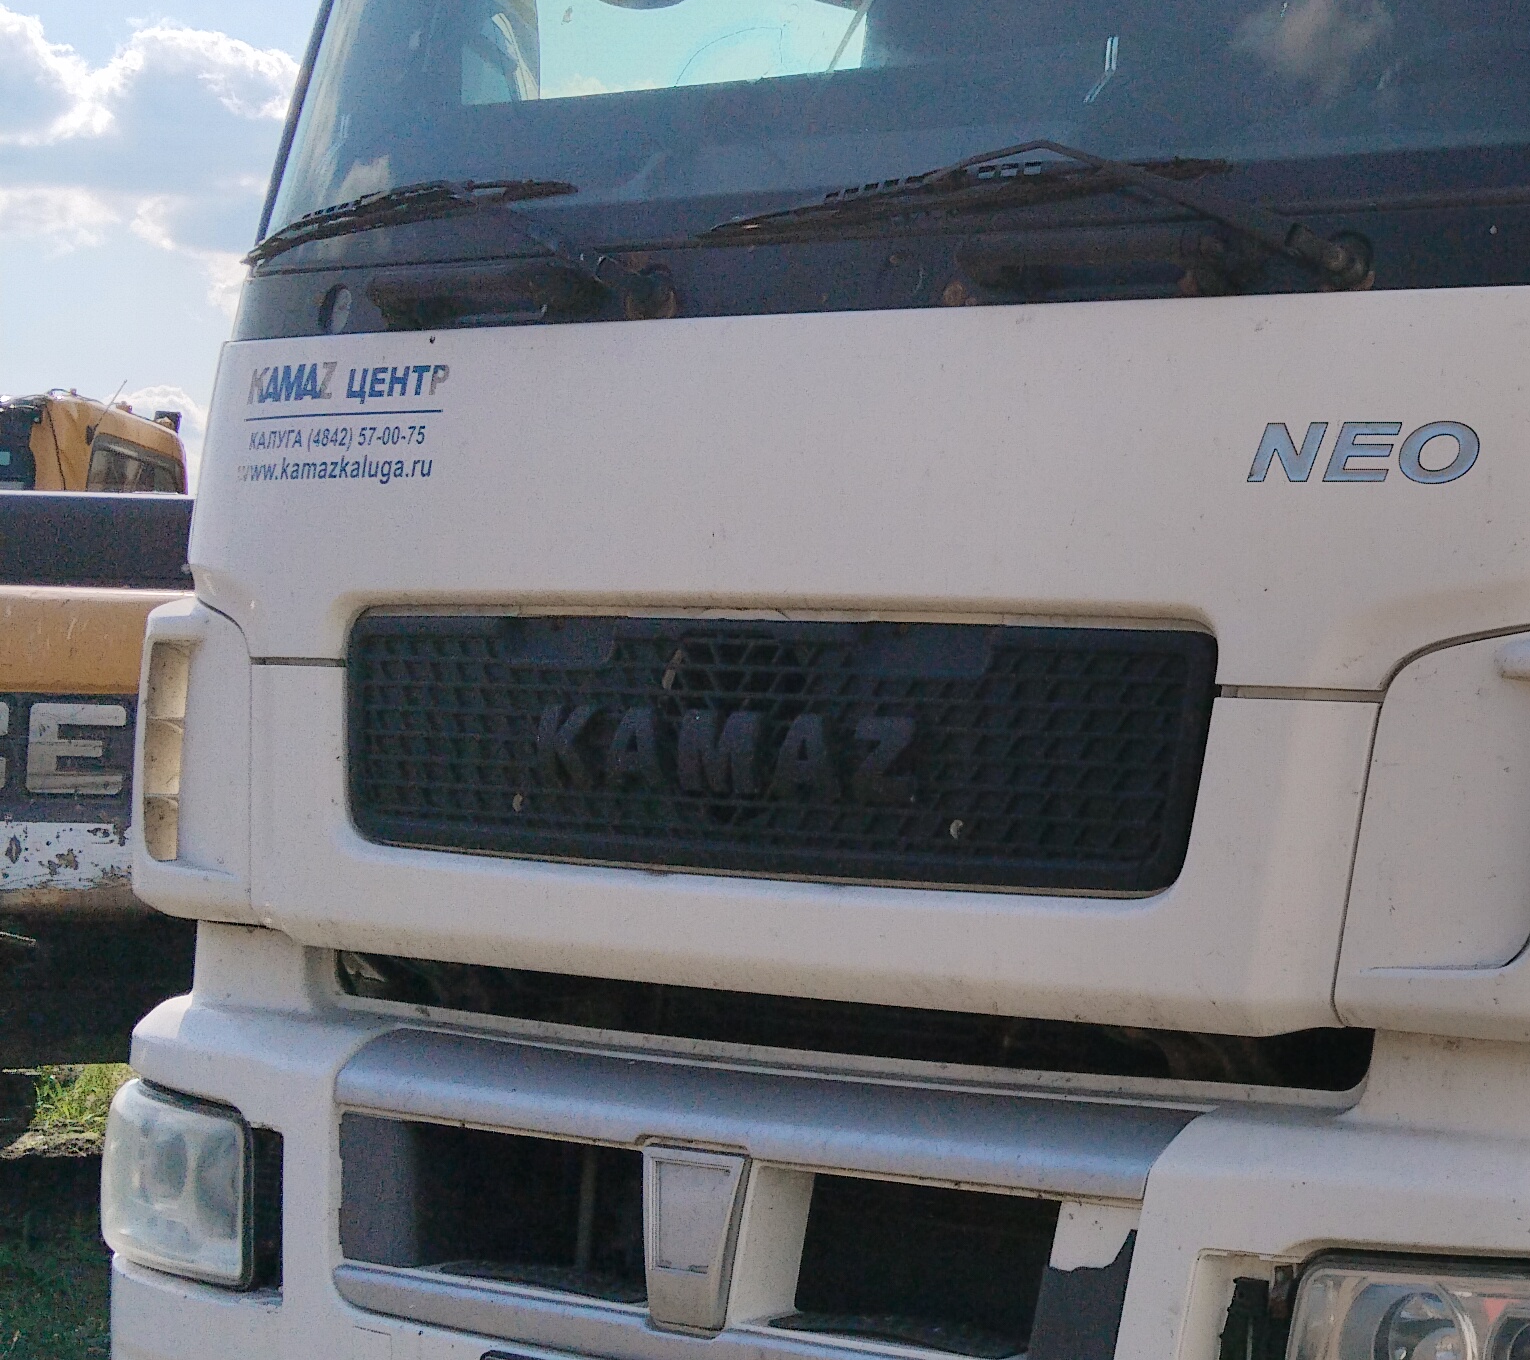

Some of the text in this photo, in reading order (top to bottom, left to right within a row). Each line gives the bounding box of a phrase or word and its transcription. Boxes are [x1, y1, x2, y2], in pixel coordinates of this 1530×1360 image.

[247, 361, 450, 405] KAMAZ ЦЕНТР
[248, 425, 426, 451] КАЛУГА (4842) 57-00-75
[1246, 420, 1480, 485] NEO
[237, 454, 433, 484] www.kamazkaluga.ru
[0, 701, 126, 795] E
[534, 704, 920, 798] KAMAZ
